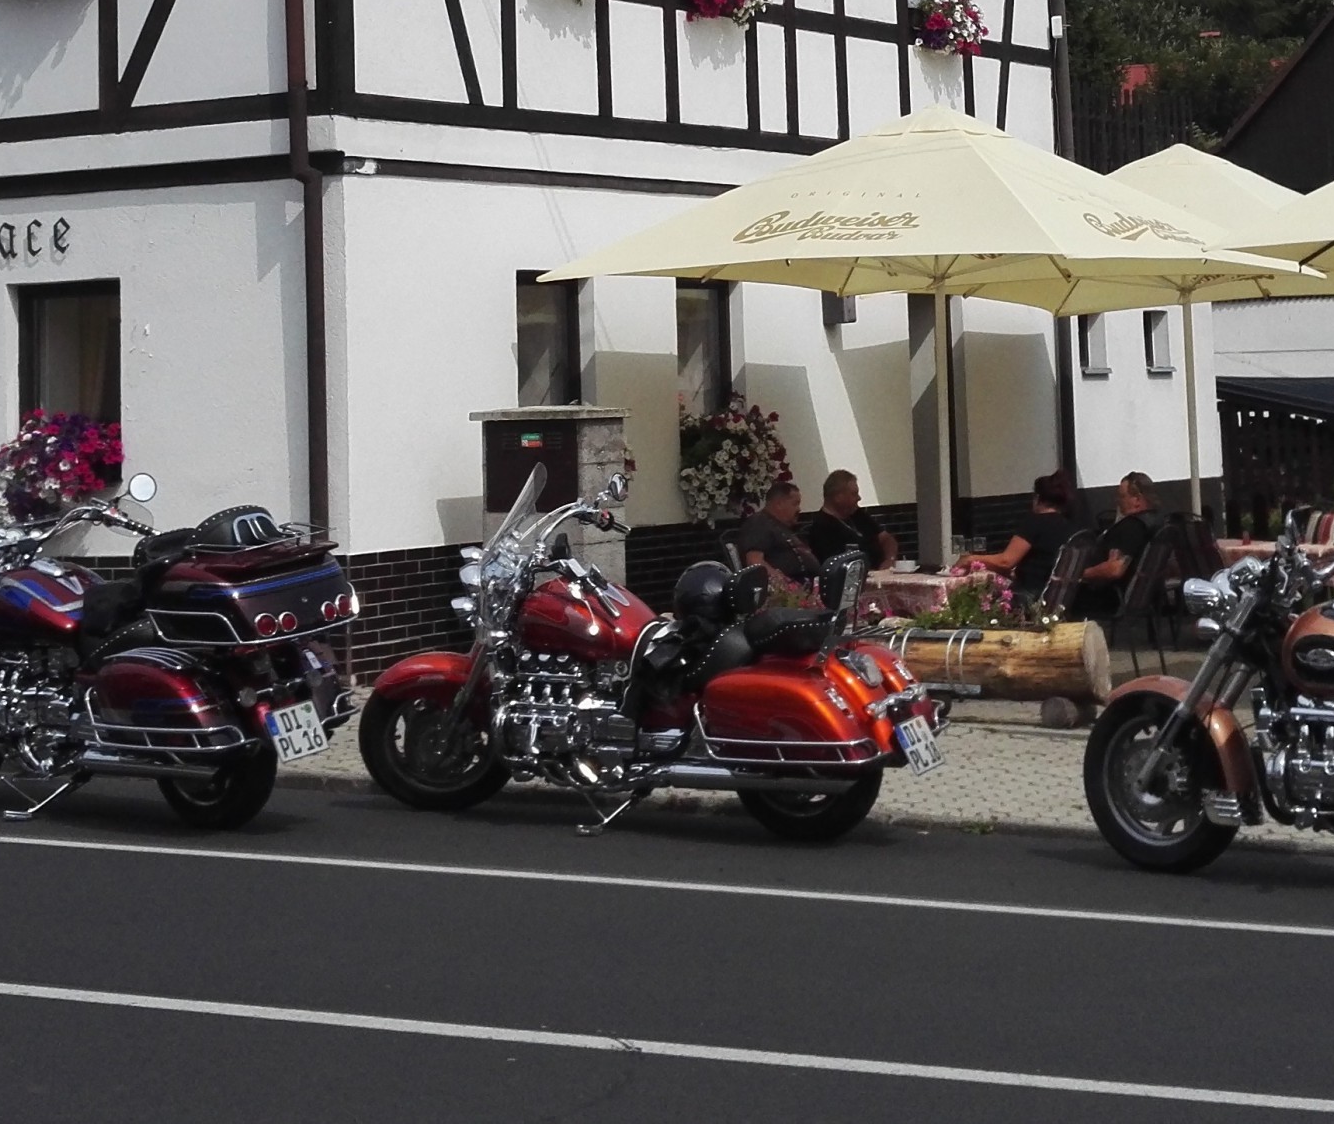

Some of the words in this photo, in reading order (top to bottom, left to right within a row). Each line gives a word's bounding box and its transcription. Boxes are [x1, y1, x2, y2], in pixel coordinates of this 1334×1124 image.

[789, 189, 922, 200] ORIGINAL
[732, 209, 922, 244] Budweiser
[797, 224, 903, 242] Budvar
[279, 709, 303, 733] DI
[278, 735, 303, 758] PL
[302, 727, 324, 751] 16
[902, 722, 922, 746] DI
[909, 748, 930, 772] PL
